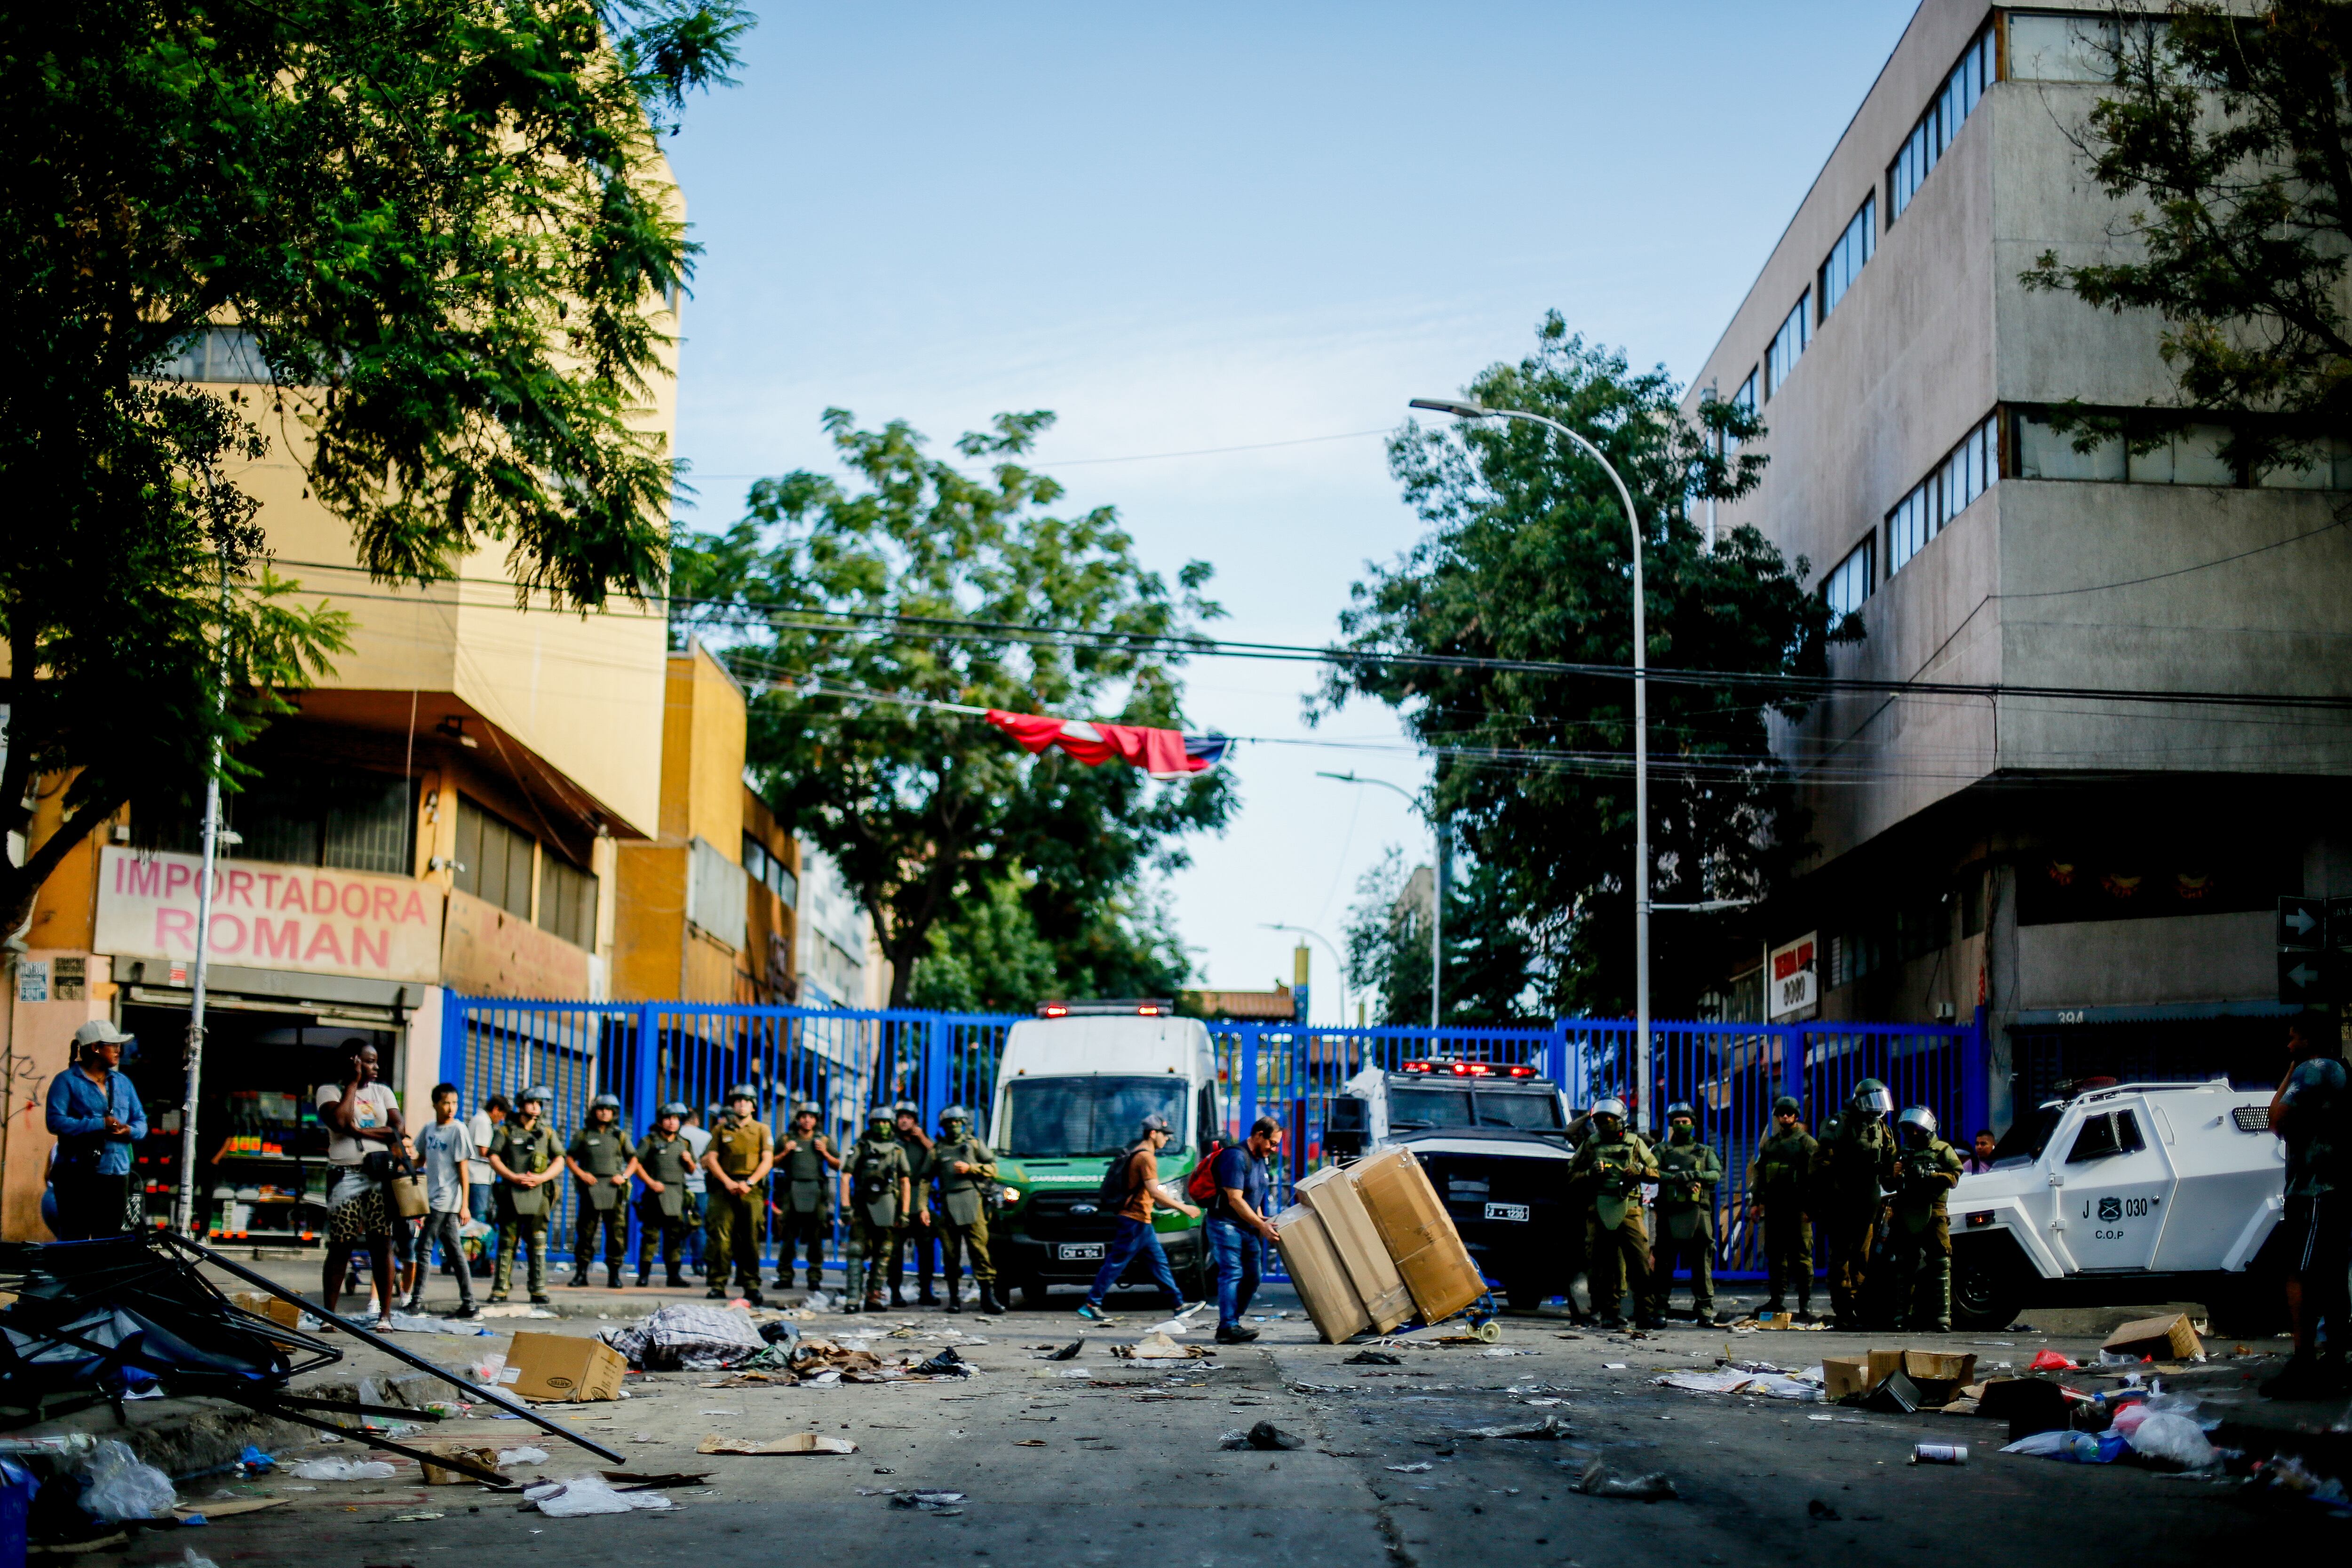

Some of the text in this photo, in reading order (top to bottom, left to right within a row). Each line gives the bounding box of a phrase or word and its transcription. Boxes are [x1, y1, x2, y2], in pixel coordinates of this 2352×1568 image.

[115, 858, 428, 926] IMPORTADORA
[154, 907, 390, 969] ROMAN
[2082, 1198, 2147, 1219] J 030
[2095, 1230, 2124, 1239] C.O.P
